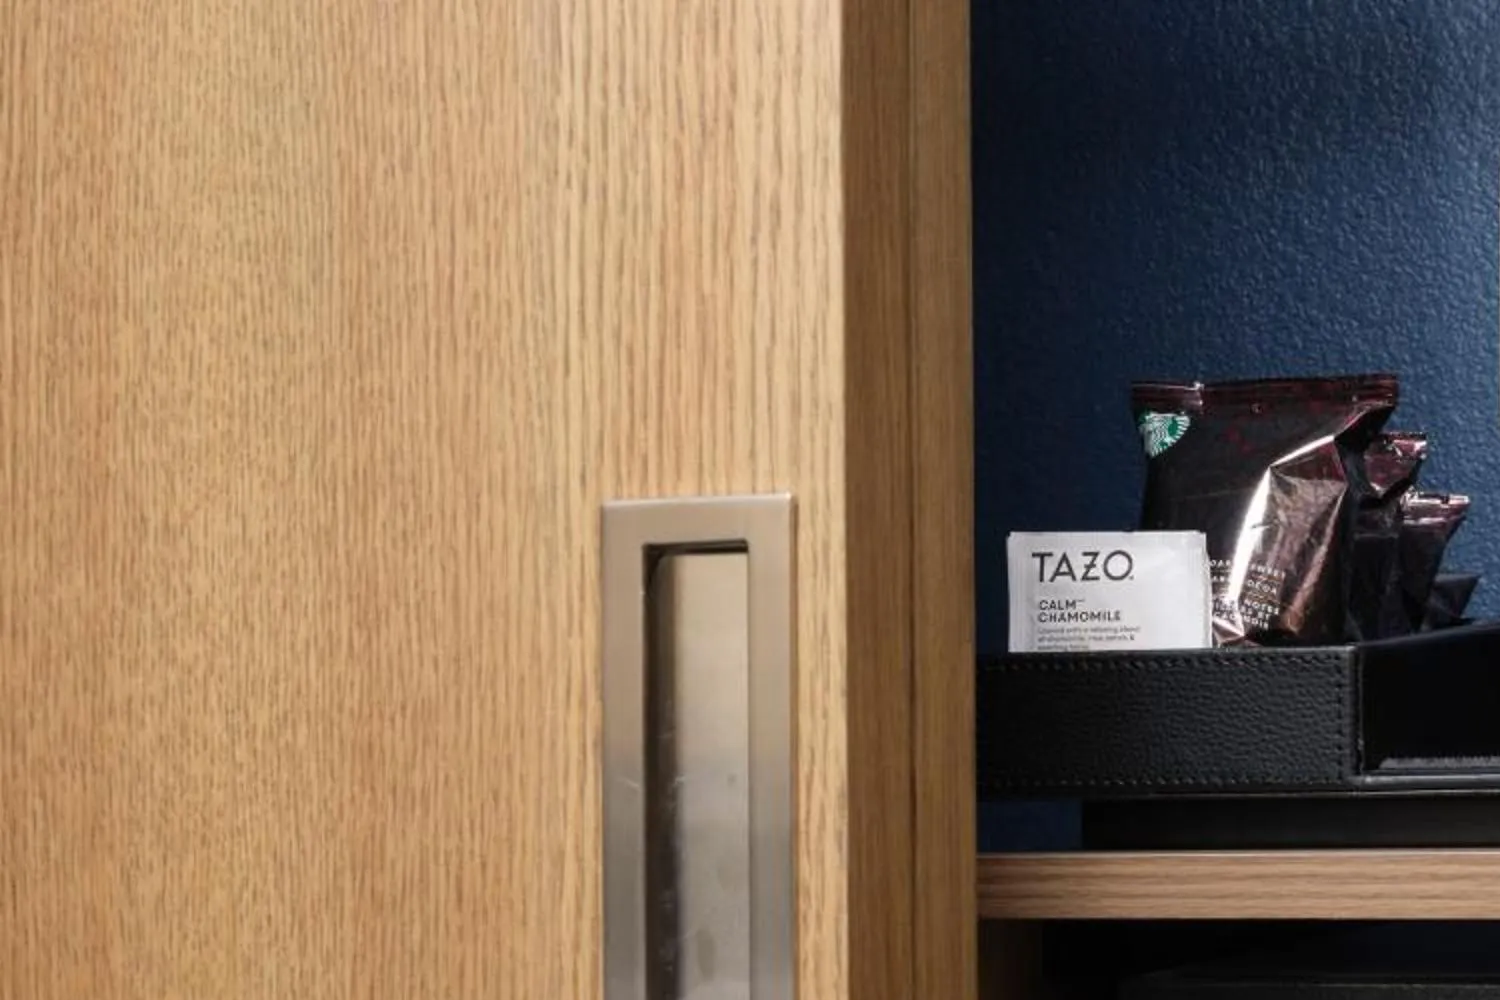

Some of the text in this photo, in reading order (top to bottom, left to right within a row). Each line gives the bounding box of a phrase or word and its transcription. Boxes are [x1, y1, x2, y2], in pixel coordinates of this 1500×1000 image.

[1031, 550, 1134, 582] TAZO
[1039, 599, 1077, 611] CALM
[1038, 611, 1121, 623] CHAMOMILE
